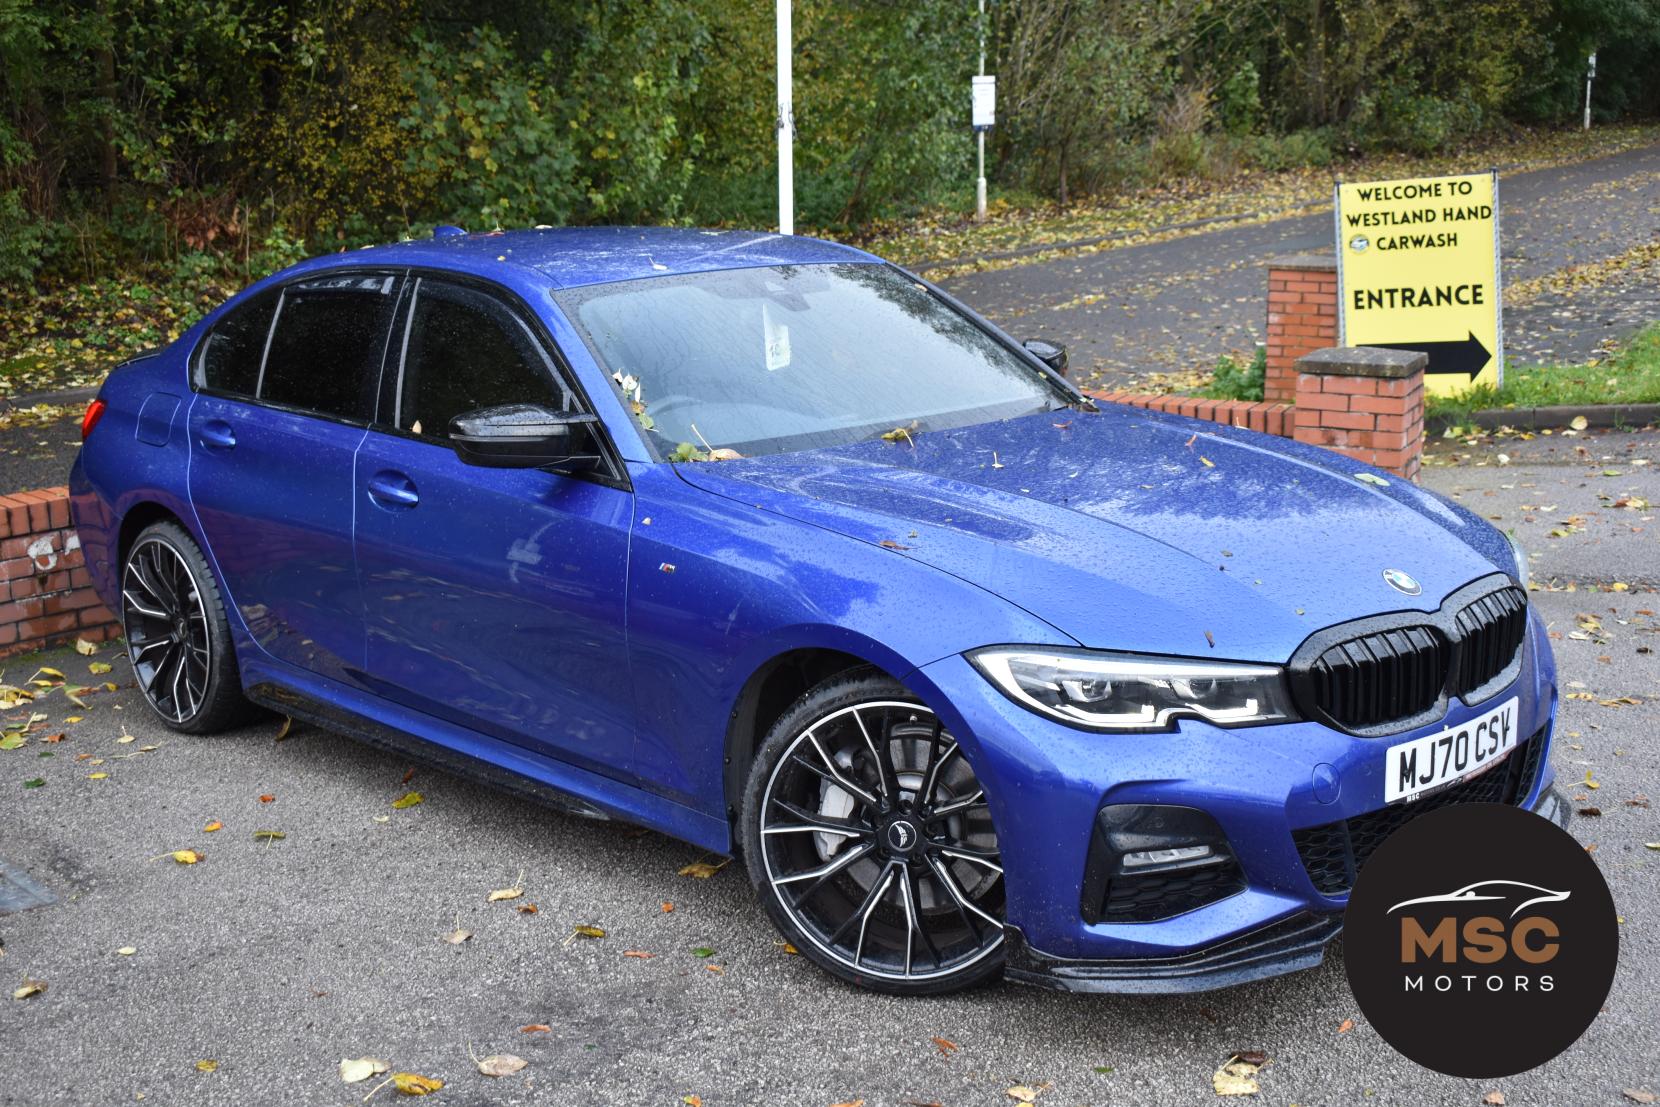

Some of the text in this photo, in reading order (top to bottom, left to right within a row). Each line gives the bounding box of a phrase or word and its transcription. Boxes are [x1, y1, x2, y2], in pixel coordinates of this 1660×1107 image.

[1358, 181, 1473, 201] WELCOME TO
[1347, 205, 1492, 227] WESTLAND HAND
[1376, 233, 1458, 250] CARWASH
[1354, 284, 1484, 310] ENTRANCE
[1399, 731, 1469, 793] MJ70
[1475, 707, 1511, 762] CSV
